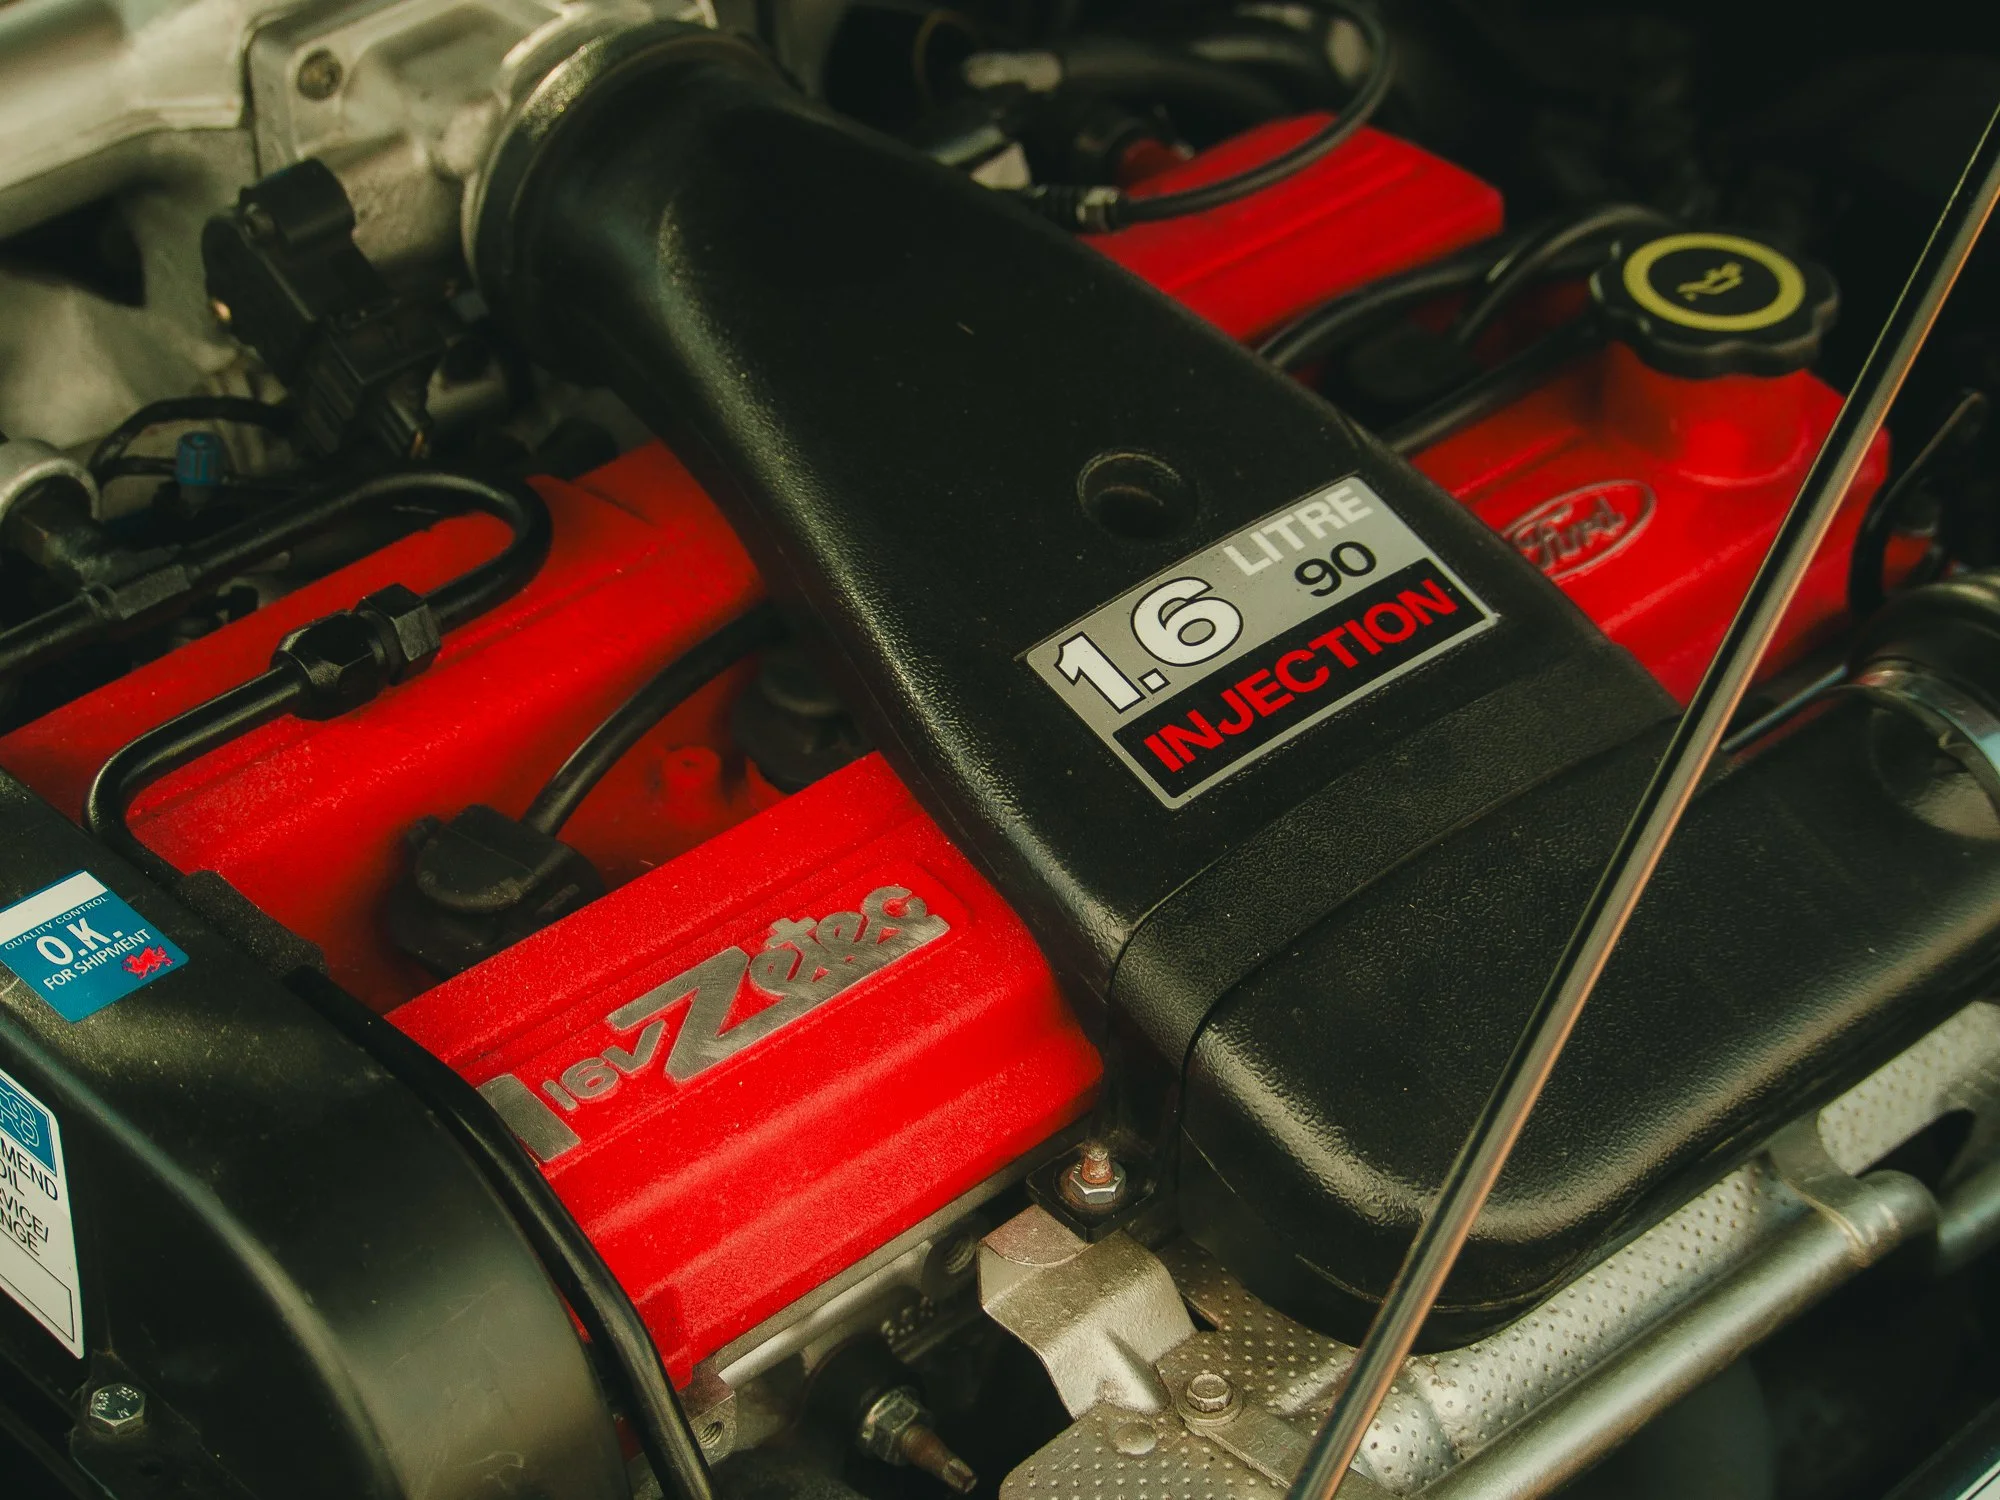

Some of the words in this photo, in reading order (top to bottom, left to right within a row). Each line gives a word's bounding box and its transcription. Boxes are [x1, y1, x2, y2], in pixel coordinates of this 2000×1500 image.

[1512, 495, 1627, 569] Ford
[1054, 576, 1245, 714] 1.6
[1223, 484, 1373, 576] LITRE
[1294, 541, 1377, 597] 90
[1144, 579, 1458, 773] INJECTION
[4, 921, 53, 950] QUALITY
[55, 896, 109, 925] CONTROL
[36, 917, 123, 965] O.K.
[43, 968, 77, 991] FOR
[74, 928, 151, 974] SHIPMENT
[605, 884, 950, 1082] Zetec
